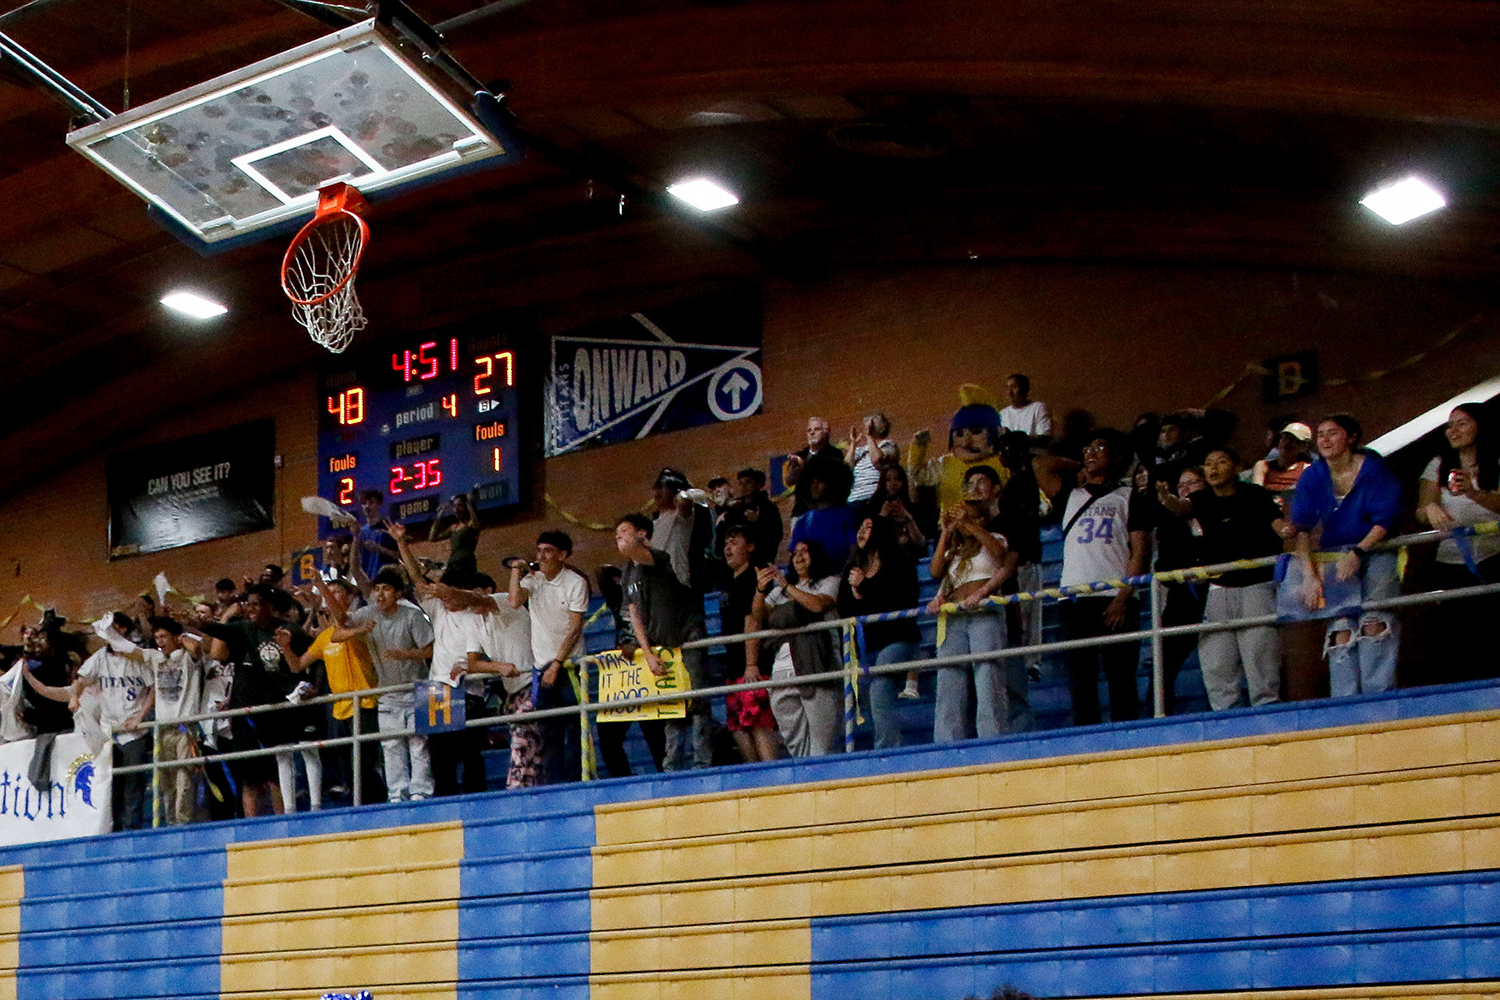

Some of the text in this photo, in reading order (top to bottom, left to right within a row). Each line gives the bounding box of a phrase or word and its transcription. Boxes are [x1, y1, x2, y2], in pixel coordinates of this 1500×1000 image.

[391, 338, 458, 382] 4:51
[473, 351, 514, 395] 27
[573, 348, 686, 431] ONWARD
[396, 393, 457, 428] period 4
[475, 421, 504, 441] fouls
[396, 437, 434, 457] player
[493, 447, 501, 472] 1
[329, 454, 356, 473] fouls
[389, 459, 442, 494] 2-35
[149, 477, 168, 495] CAN
[171, 471, 190, 490] YOU
[192, 465, 212, 484] SEE
[214, 462, 230, 480] IT?
[340, 477, 353, 505] 2
[400, 499, 430, 519] game
[1084, 506, 1116, 518] ITANS
[1077, 517, 1114, 544] 34
[602, 667, 642, 689] IT THE
[127, 686, 137, 701] 8
[429, 687, 451, 727] H
